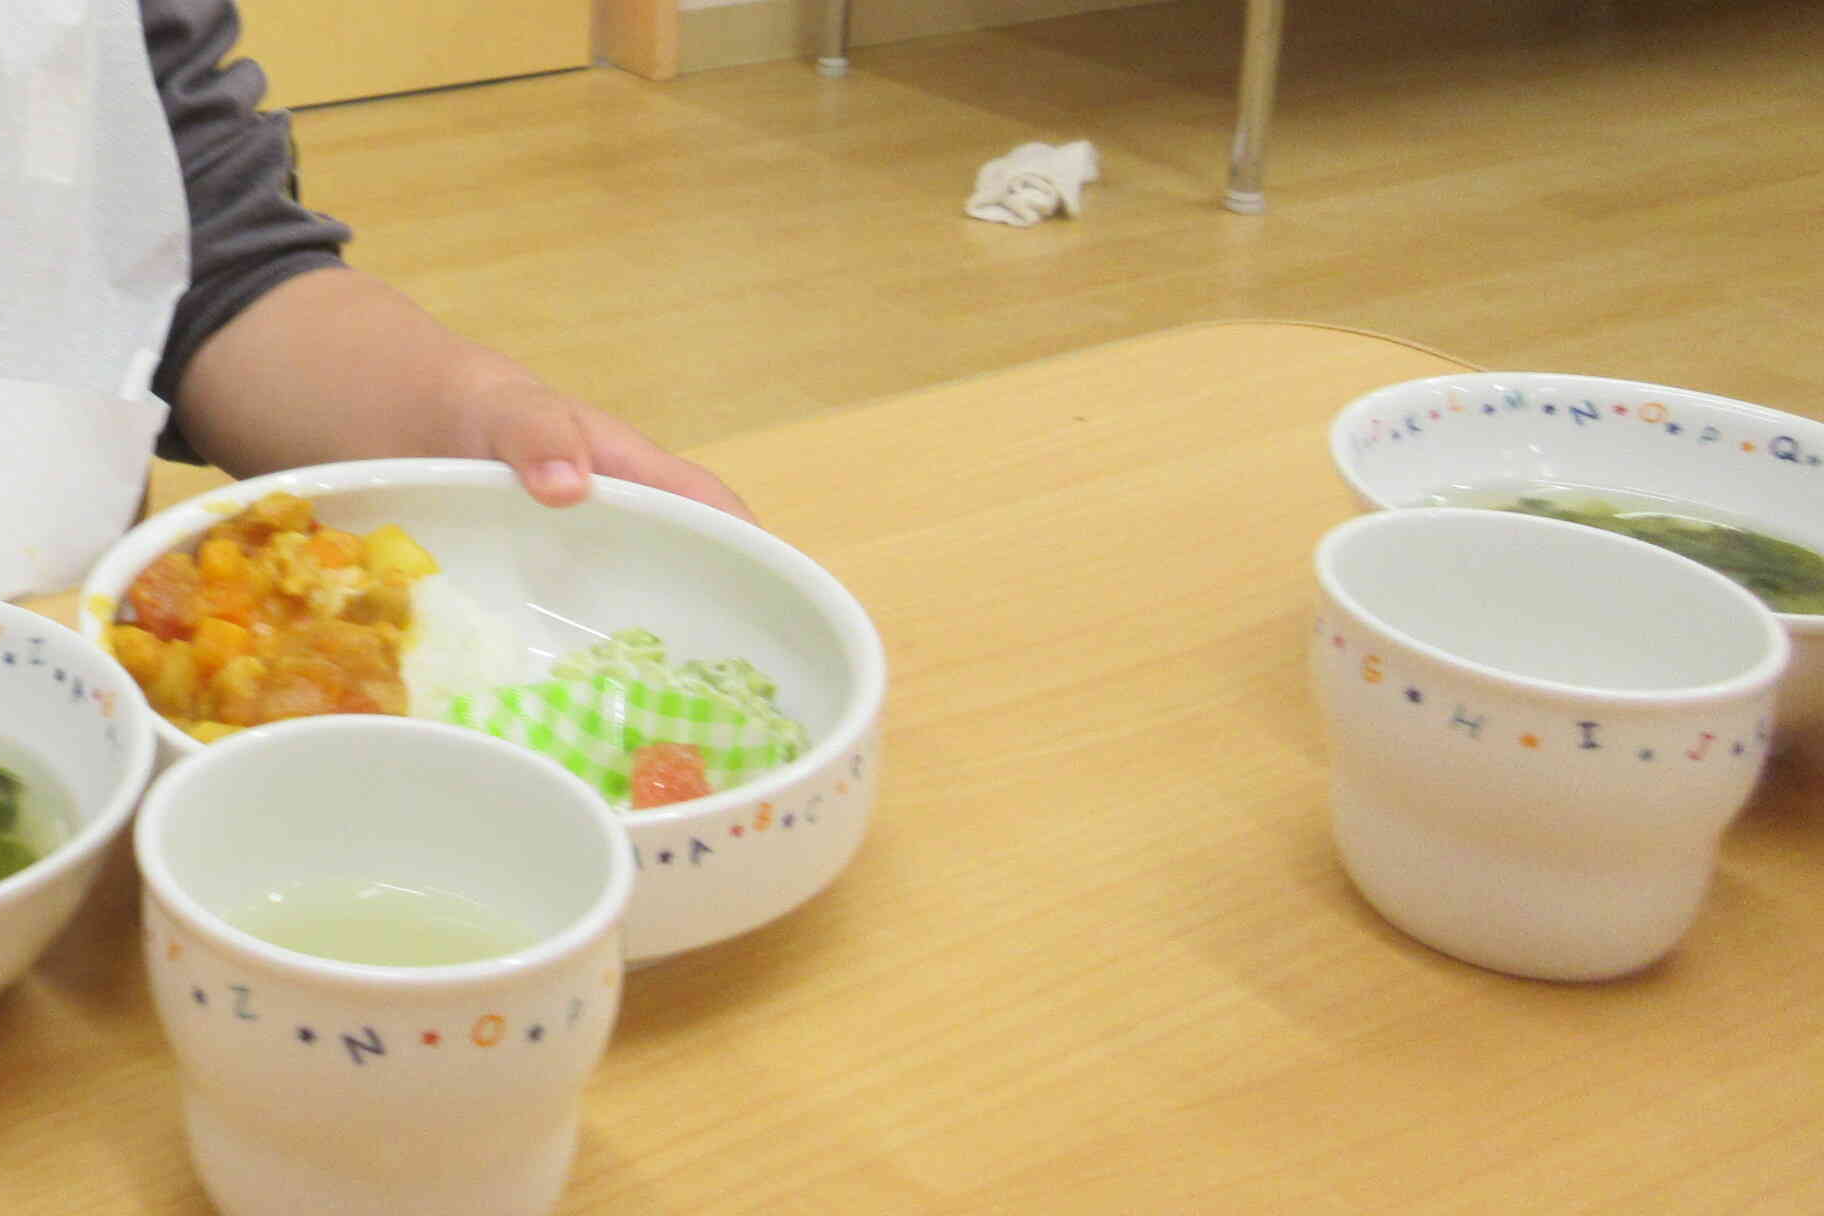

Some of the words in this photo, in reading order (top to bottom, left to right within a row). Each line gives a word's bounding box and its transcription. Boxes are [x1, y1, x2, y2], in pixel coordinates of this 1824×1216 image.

[1638, 402, 1666, 424] O
[1769, 434, 1800, 464] Q
[1576, 720, 1602, 751] I
[339, 1025, 386, 1066] N
[471, 1013, 505, 1048] O
